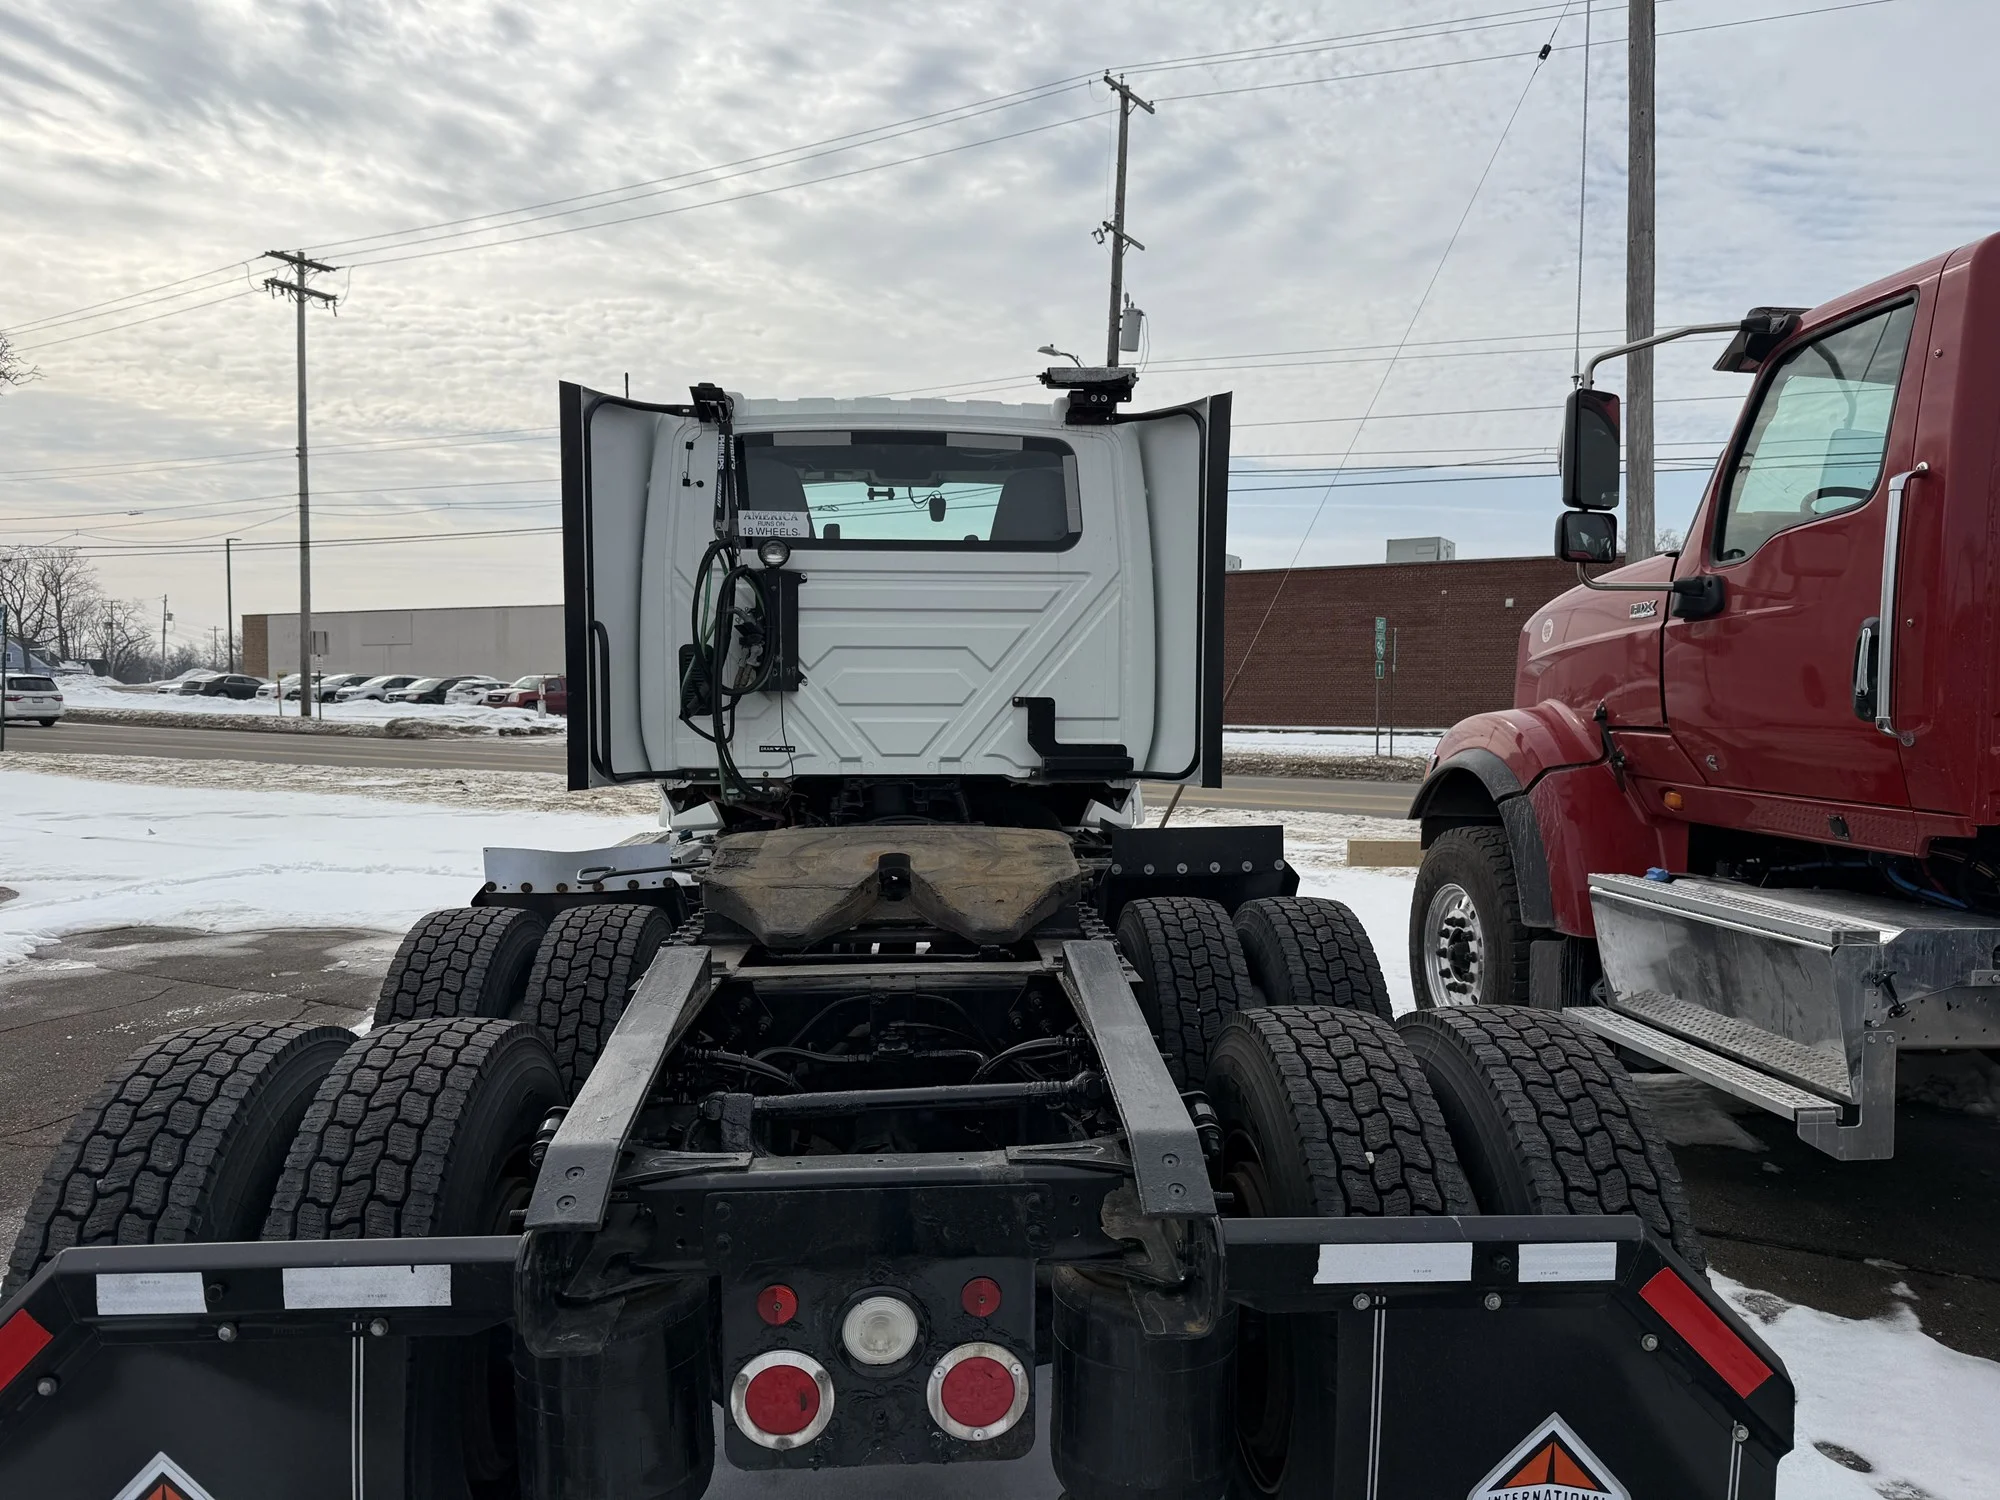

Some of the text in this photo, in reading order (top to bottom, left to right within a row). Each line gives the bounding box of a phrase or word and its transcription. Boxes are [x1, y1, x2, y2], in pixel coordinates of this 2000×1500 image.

[743, 511, 799, 521] AMERICA
[743, 527, 754, 536] 18
[1488, 1489, 1606, 1500] TERNATION
